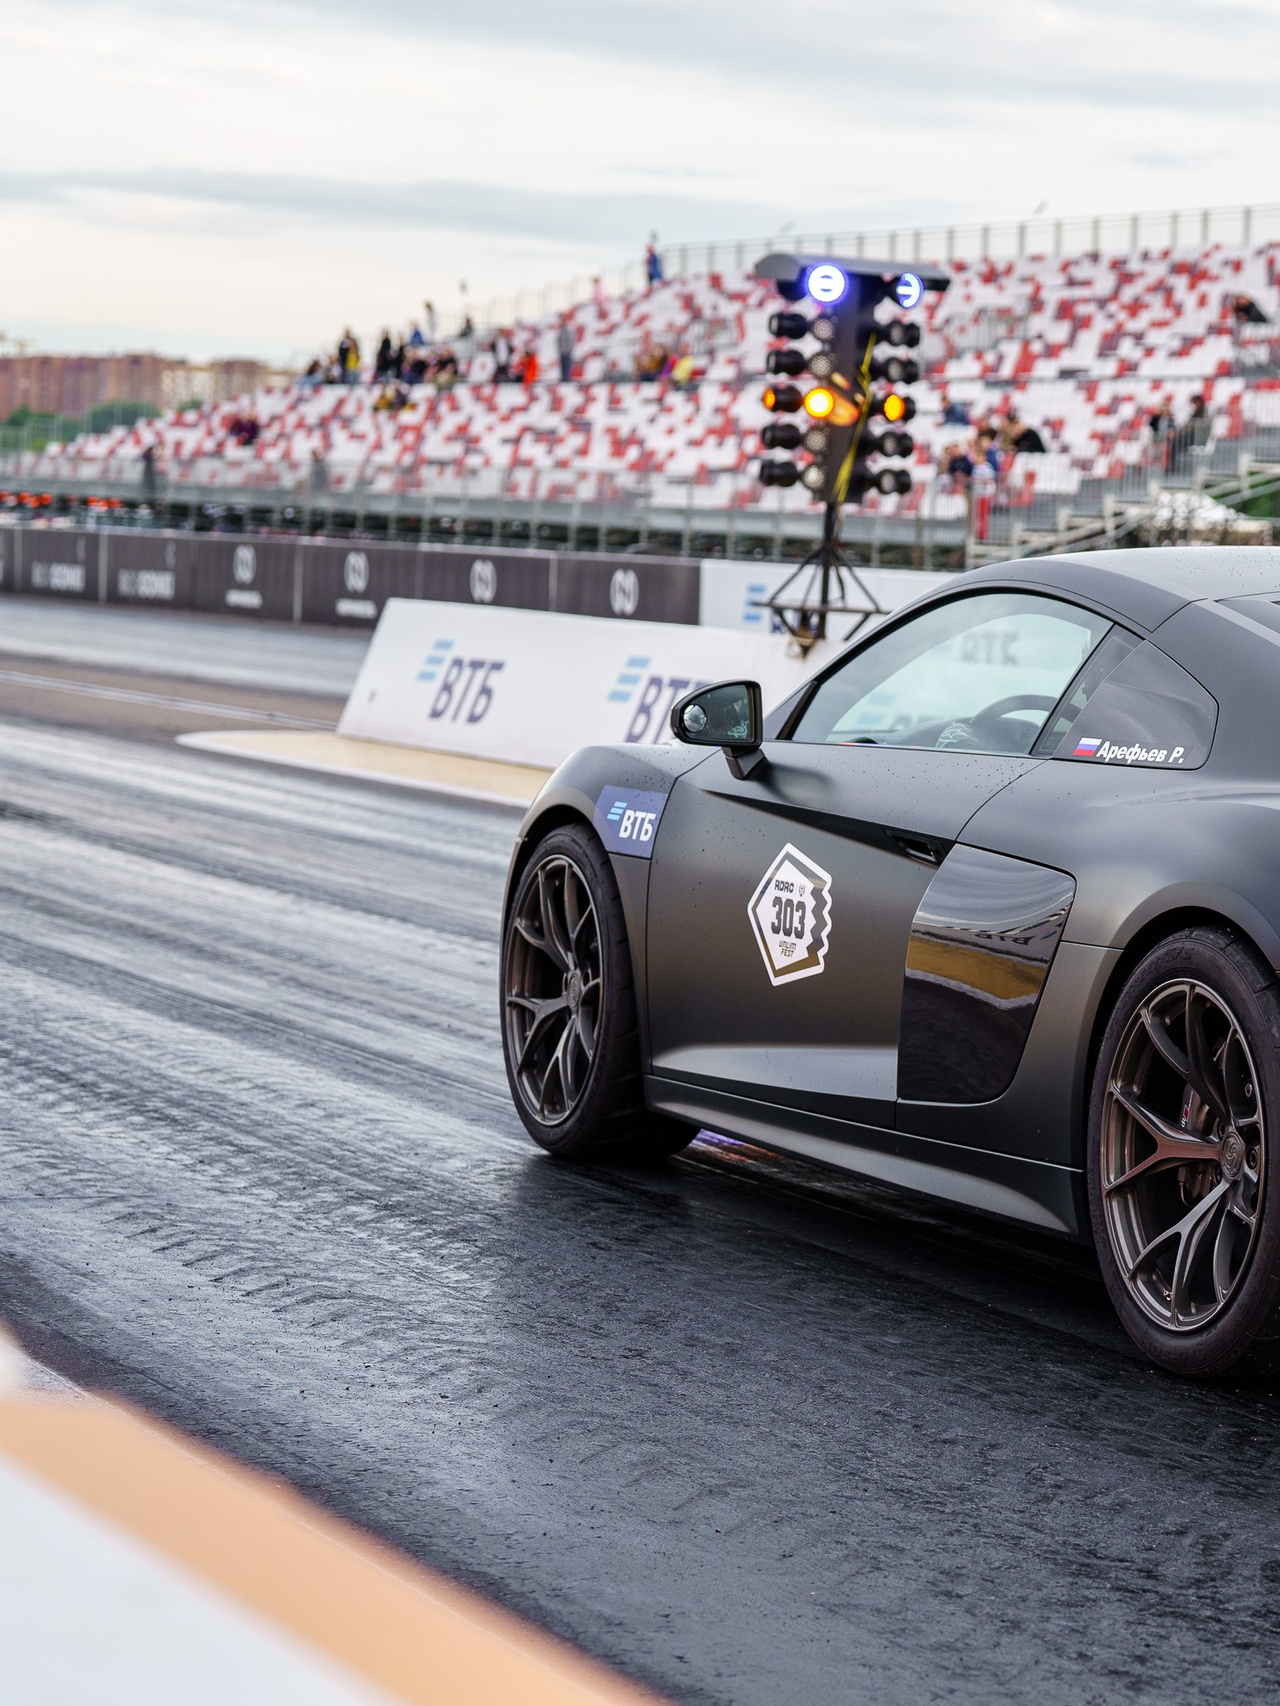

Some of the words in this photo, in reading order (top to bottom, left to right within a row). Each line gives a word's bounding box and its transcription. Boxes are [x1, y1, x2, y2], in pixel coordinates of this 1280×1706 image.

[429, 657, 506, 725] ВТБ
[624, 677, 712, 743] ВТ
[1096, 741, 1168, 764] Арефьев
[618, 809, 657, 842] ВТБ
[771, 896, 806, 939] 303
[781, 948, 794, 957] FEST
